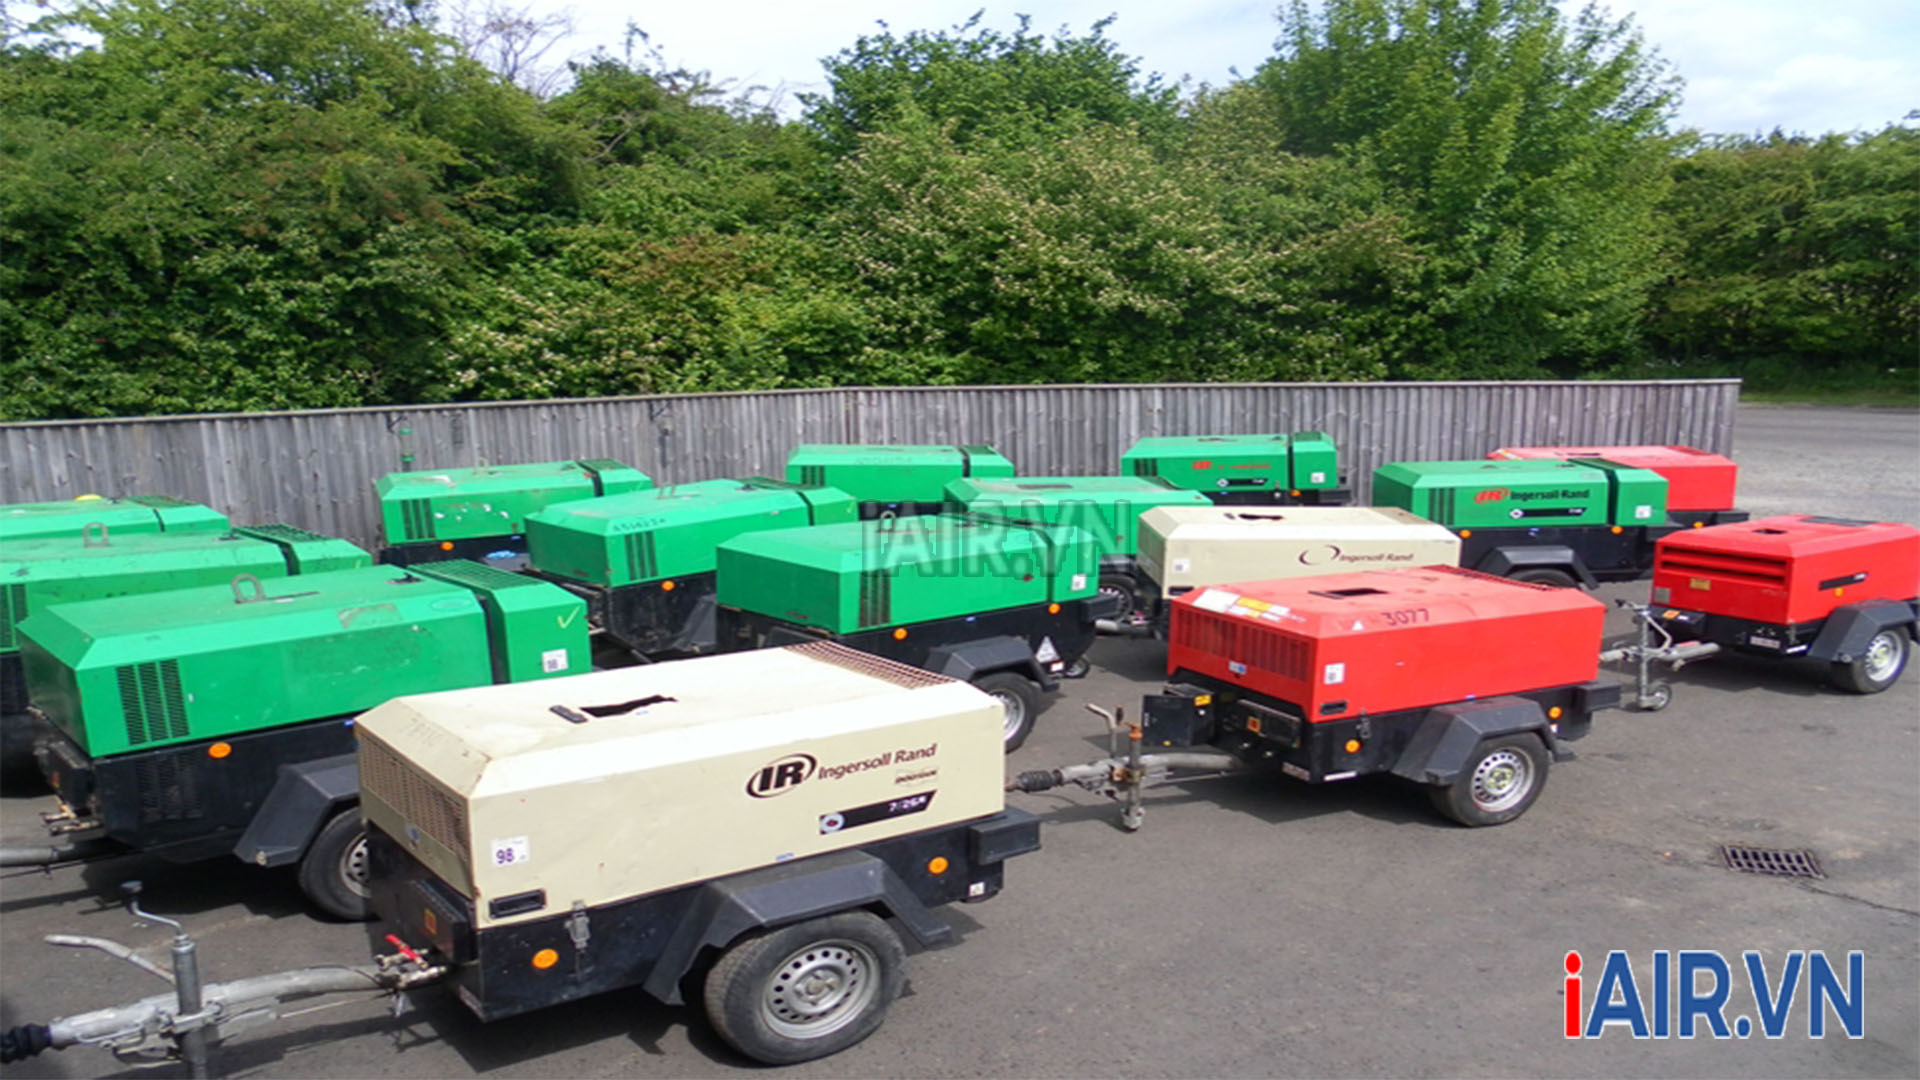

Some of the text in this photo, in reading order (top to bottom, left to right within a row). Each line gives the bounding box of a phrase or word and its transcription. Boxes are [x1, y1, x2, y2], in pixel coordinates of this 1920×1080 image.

[1561, 488, 1591, 500] Rand
[1382, 608, 1430, 626] 3077
[756, 742, 939, 793] IR Ingersoll Rand
[496, 847, 515, 865] 98
